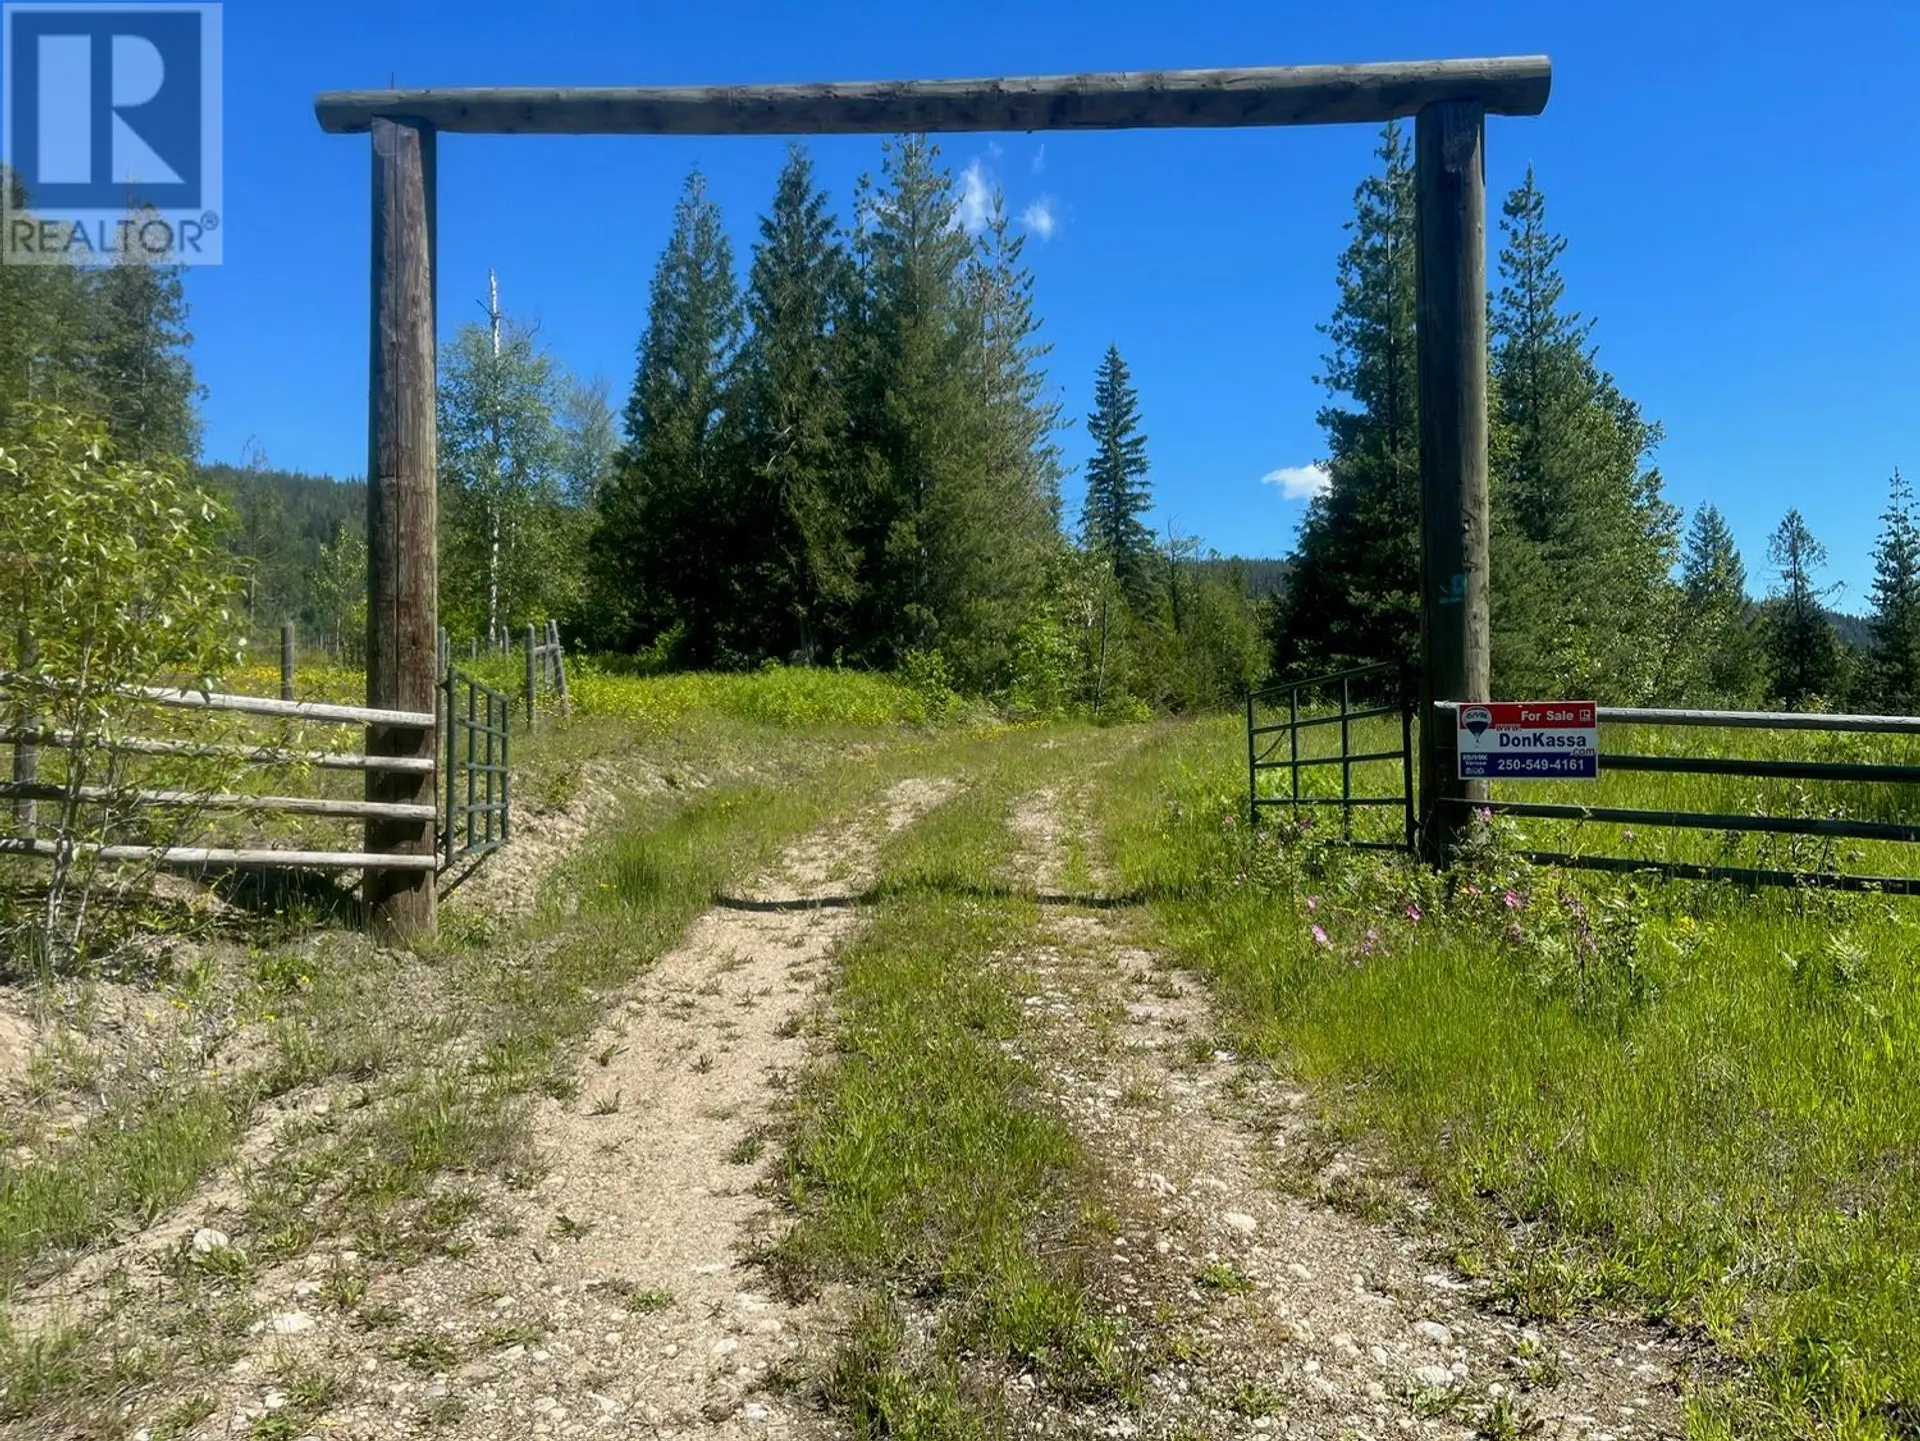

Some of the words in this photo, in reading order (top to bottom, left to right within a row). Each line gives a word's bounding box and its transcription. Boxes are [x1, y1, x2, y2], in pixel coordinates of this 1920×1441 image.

[1521, 711, 1541, 721] For
[1546, 710, 1574, 721] Sale
[1499, 732, 1586, 747] DonKassa
[1497, 759, 1584, 771] 250-549-4161
